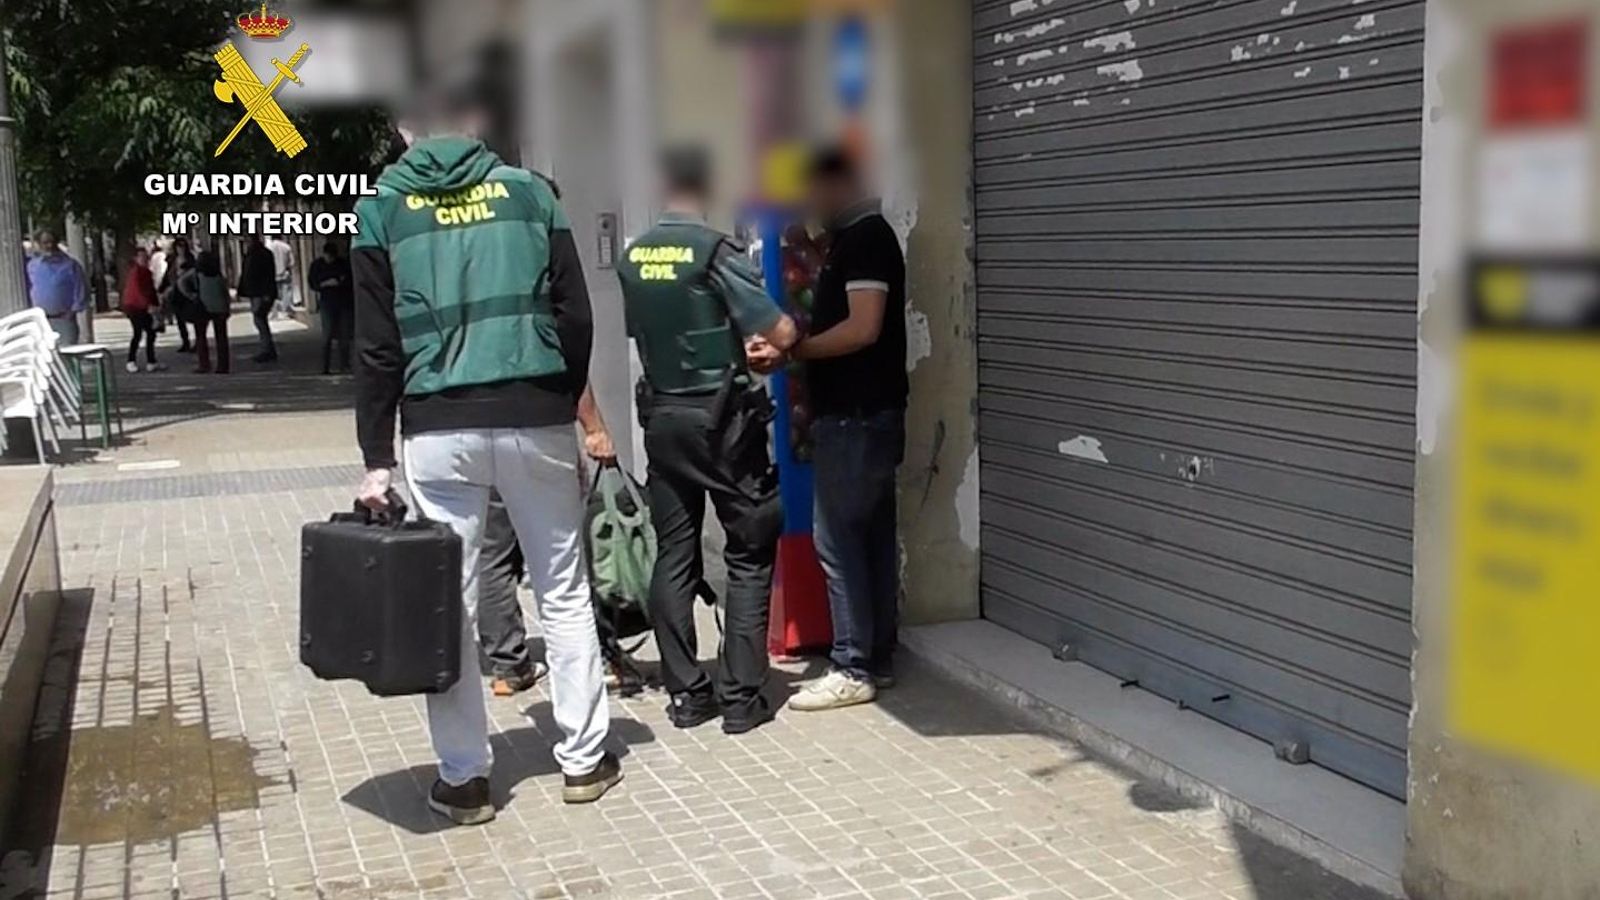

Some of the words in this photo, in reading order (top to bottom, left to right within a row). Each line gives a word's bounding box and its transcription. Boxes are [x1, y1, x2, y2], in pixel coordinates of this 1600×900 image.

[435, 202, 496, 225] CIVIL
[629, 246, 694, 263] GUARDIA
[640, 264, 678, 280] CIVIL
